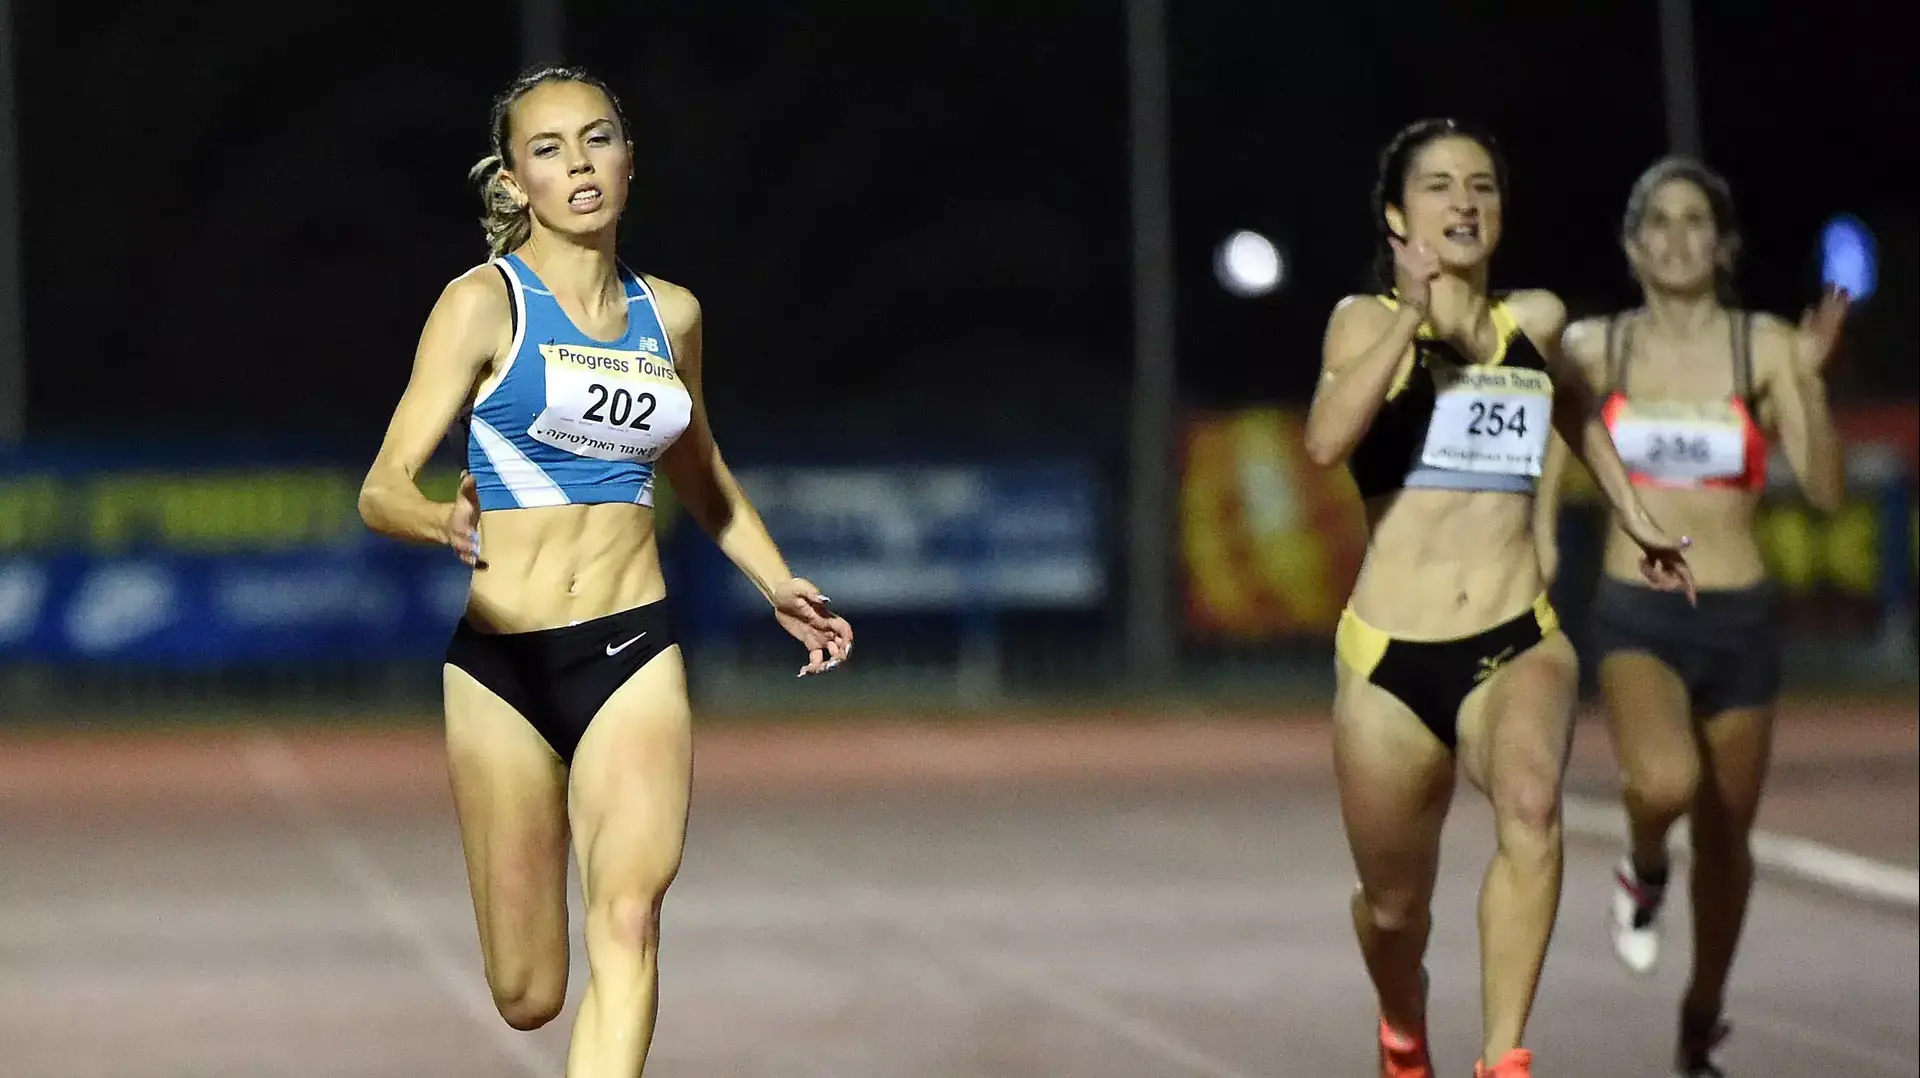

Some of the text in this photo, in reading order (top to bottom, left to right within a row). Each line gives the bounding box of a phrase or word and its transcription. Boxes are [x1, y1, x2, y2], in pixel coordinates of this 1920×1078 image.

[559, 349, 674, 380] Progress Tours
[582, 383, 657, 431] 202
[1468, 401, 1527, 438] 254
[546, 428, 615, 452] האתלטיקה
[619, 443, 648, 456] איגוד
